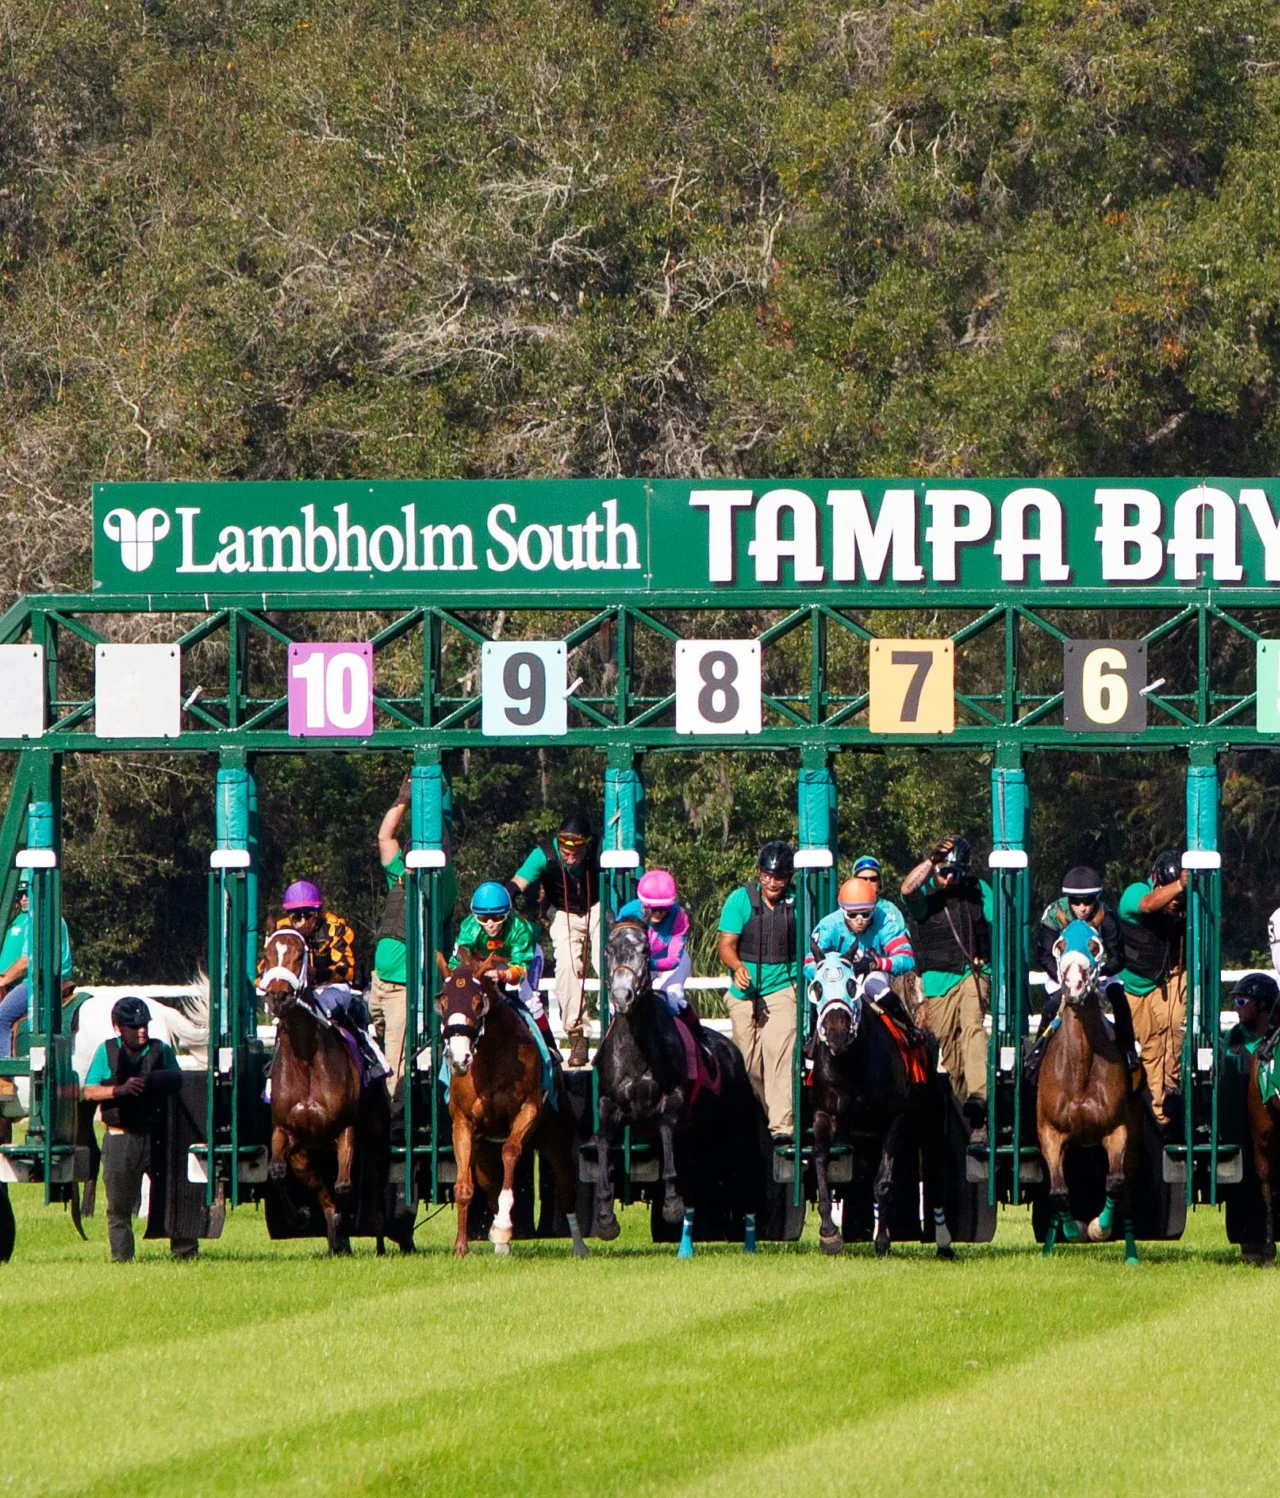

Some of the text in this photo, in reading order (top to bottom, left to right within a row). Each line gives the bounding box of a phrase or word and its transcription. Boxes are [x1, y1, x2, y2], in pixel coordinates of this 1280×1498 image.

[176, 499, 642, 573] Lambholm South
[689, 488, 1072, 583] TAMPA
[292, 653, 369, 728] 10
[503, 653, 546, 725] 9
[698, 652, 740, 723] 8
[892, 652, 933, 722] 7
[1082, 648, 1129, 724] 6
